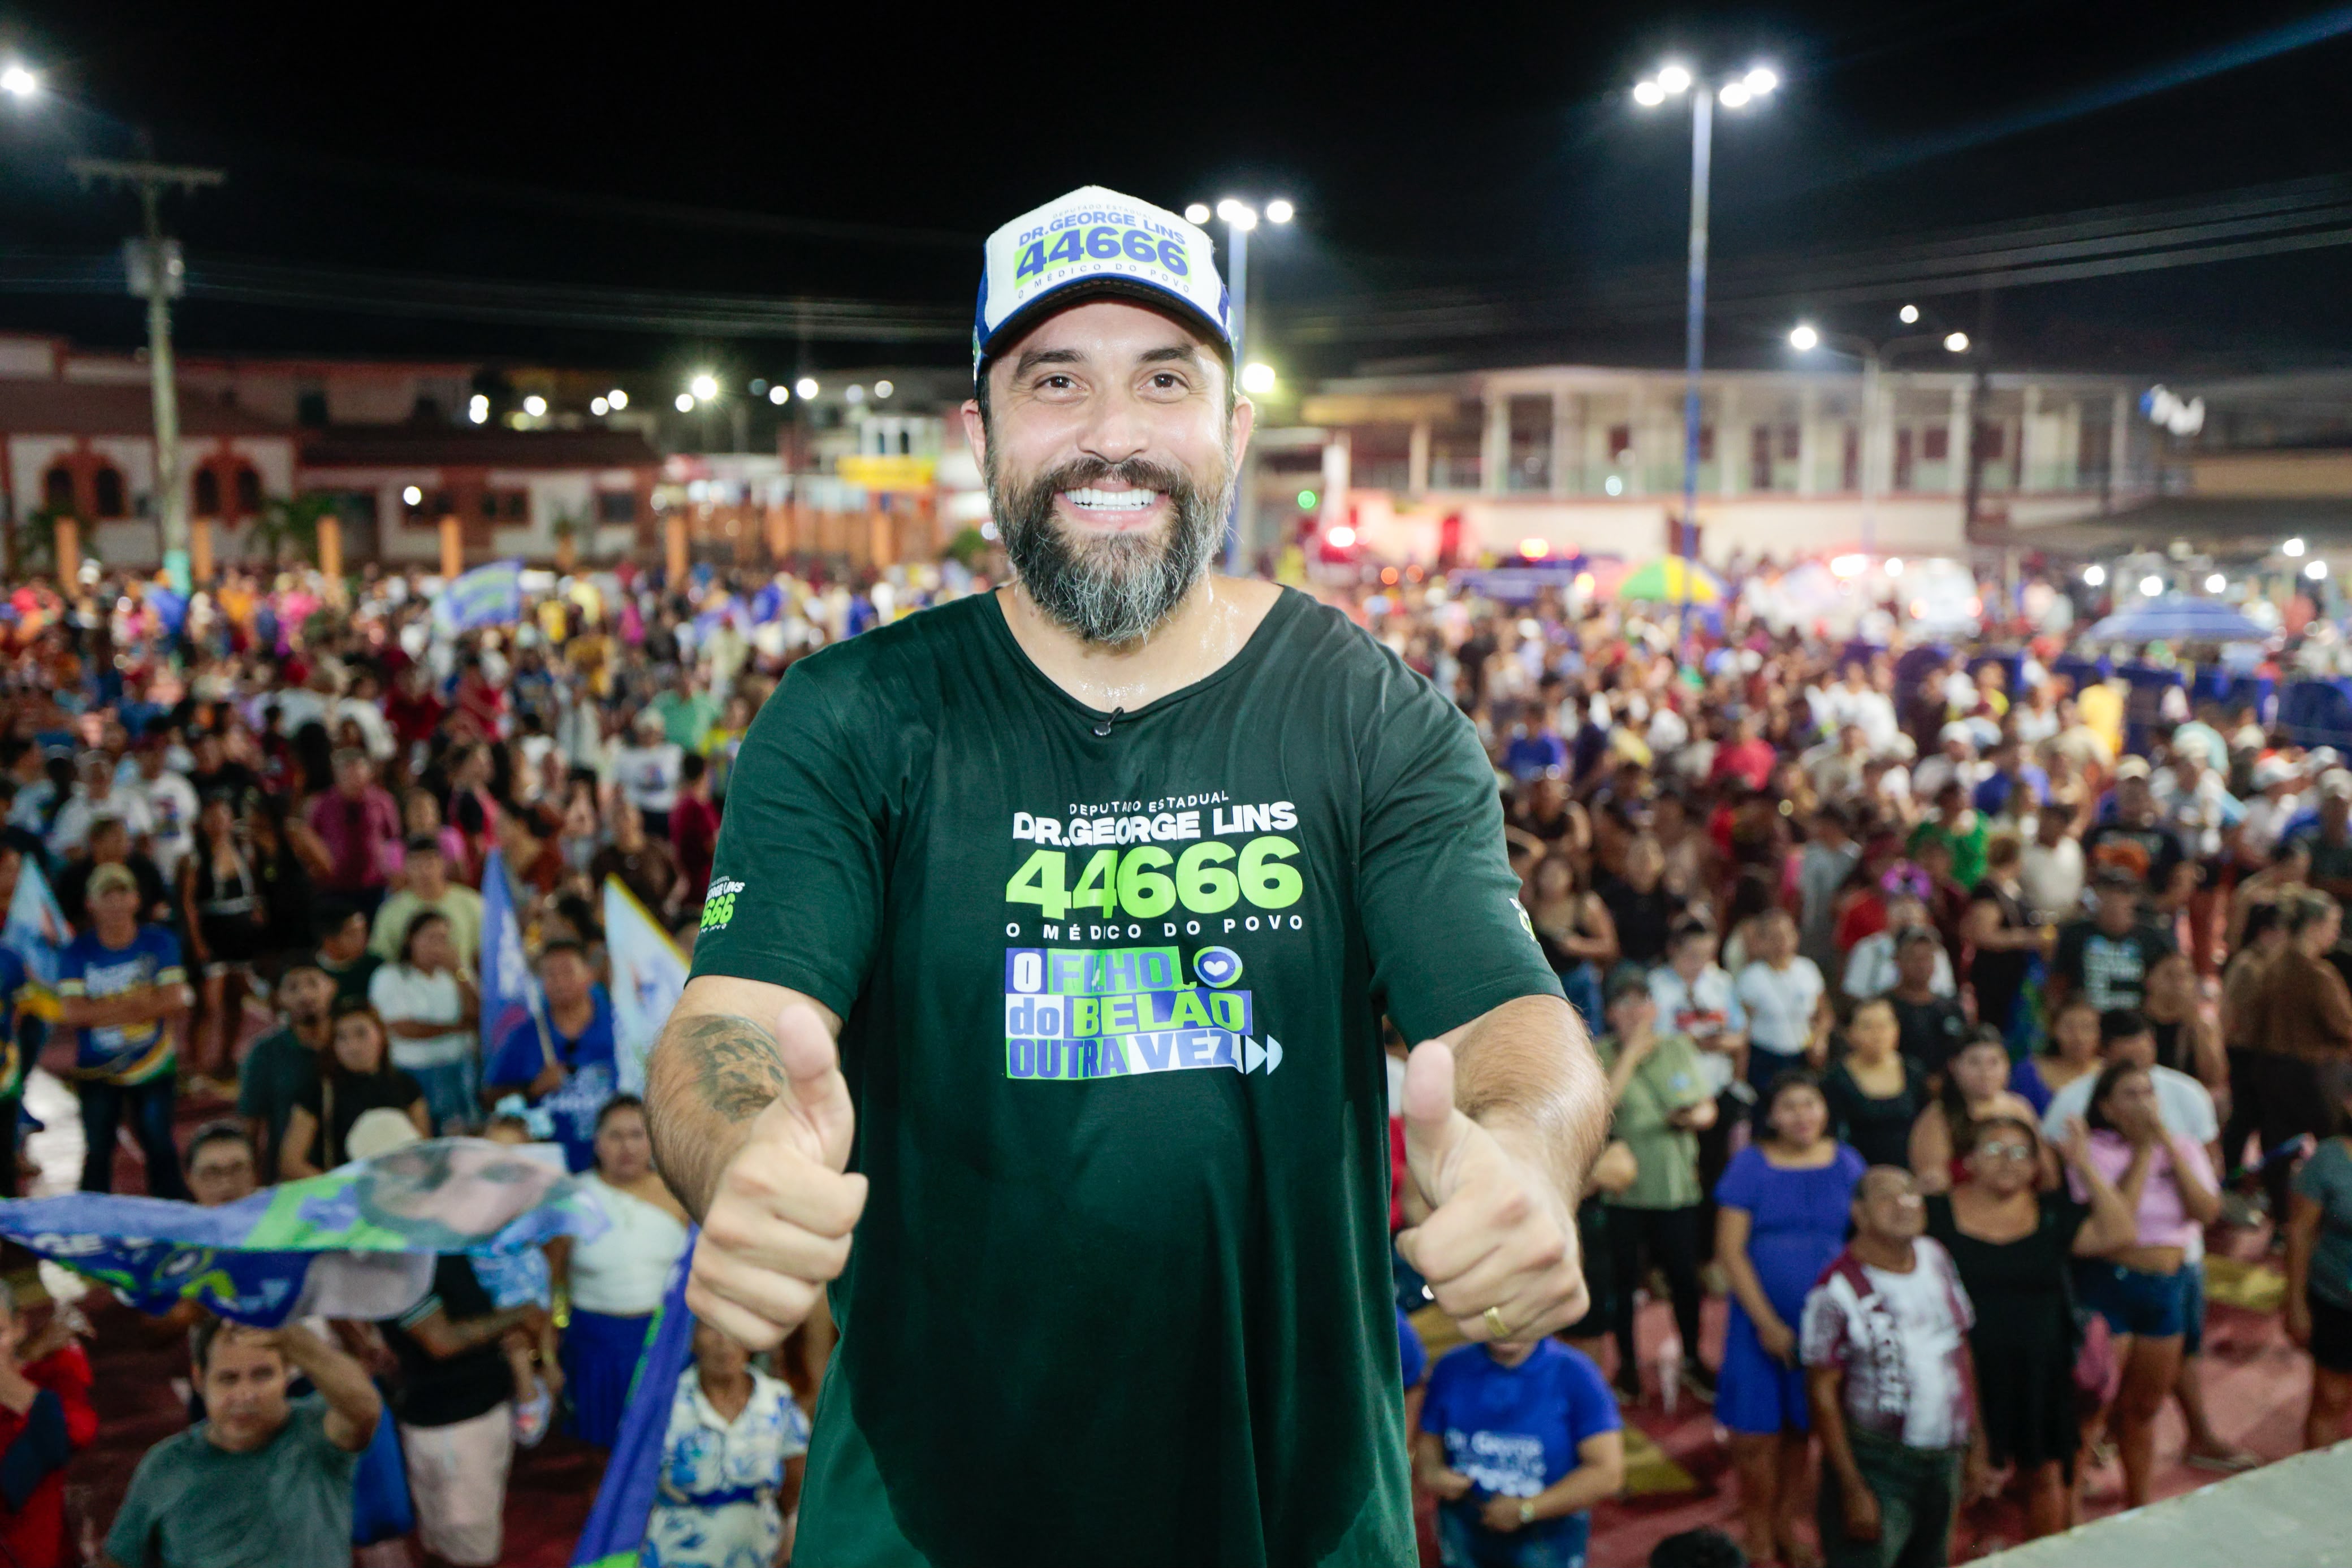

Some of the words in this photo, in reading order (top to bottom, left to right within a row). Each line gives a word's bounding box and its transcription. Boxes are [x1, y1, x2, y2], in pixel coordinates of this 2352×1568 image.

[1019, 211, 1136, 246] DR.GEORGE
[1144, 219, 1186, 245] LINS
[1017, 226, 1188, 279] 44666
[1018, 289, 1023, 299] O
[1035, 263, 1101, 288] MÉDICO
[1151, 269, 1189, 293] POVO
[1070, 800, 1141, 816] DEPUTADO
[1149, 790, 1229, 812] ESTADUAL
[1013, 811, 1200, 847] DR.GEORGE
[1213, 802, 1298, 835] LINS
[1006, 836, 1303, 920] 44666
[701, 893, 735, 928] 666
[1006, 923, 1019, 937] O
[1043, 923, 1141, 941] MÉDICO
[1164, 921, 1200, 937] DO
[1223, 915, 1302, 933] POVO
[1013, 952, 1041, 993] O
[1009, 997, 1060, 1036] do
[1073, 981, 1244, 1038] BELÃO
[1009, 1038, 1129, 1078] OUTRA
[1134, 1029, 1238, 1070] VEZ
